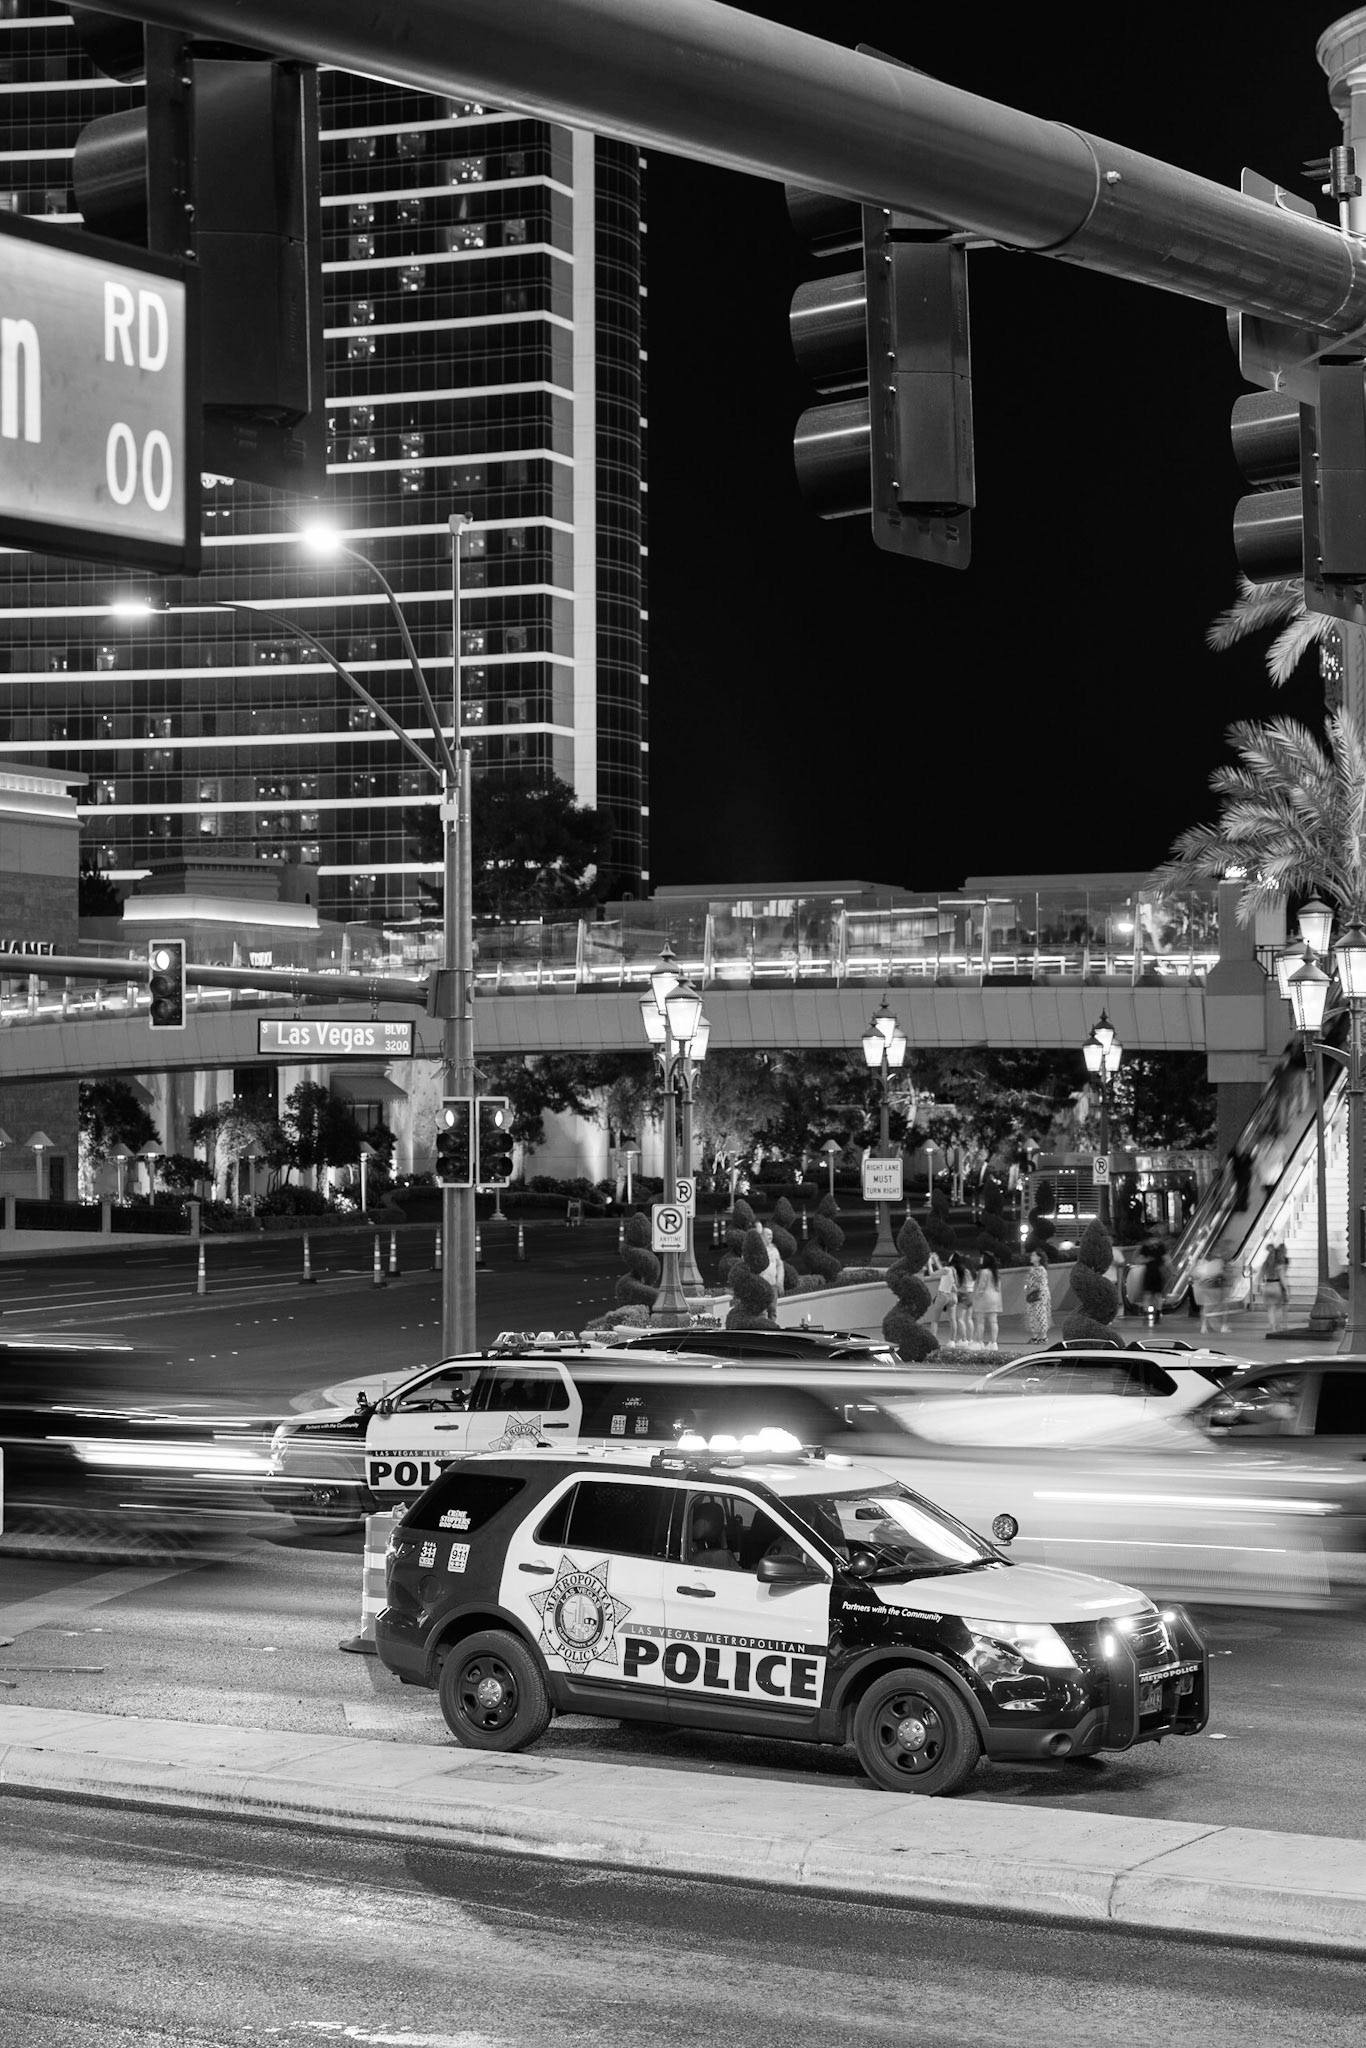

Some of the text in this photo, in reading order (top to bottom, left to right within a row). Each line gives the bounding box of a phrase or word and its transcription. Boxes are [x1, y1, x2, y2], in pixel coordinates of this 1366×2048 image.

[103, 280, 169, 373] RD
[105, 422, 173, 512] 00
[261, 1021, 409, 1053] S Las Vegas BLVD
[384, 1040, 409, 1051] 3200
[873, 1175, 892, 1183] MUST
[659, 1235, 682, 1243] ANYTIME
[545, 1574, 614, 1622] METROPOLITAN
[560, 1586, 602, 1609] LAS VEGAS
[841, 1600, 944, 1624] Partners with the Community
[631, 1624, 806, 1653] LAS VEGAS METROPOLITAN
[556, 1642, 600, 1661] POLICE
[623, 1637, 818, 1701] POLICE
[1140, 1664, 1199, 1683] METRO POLICE
